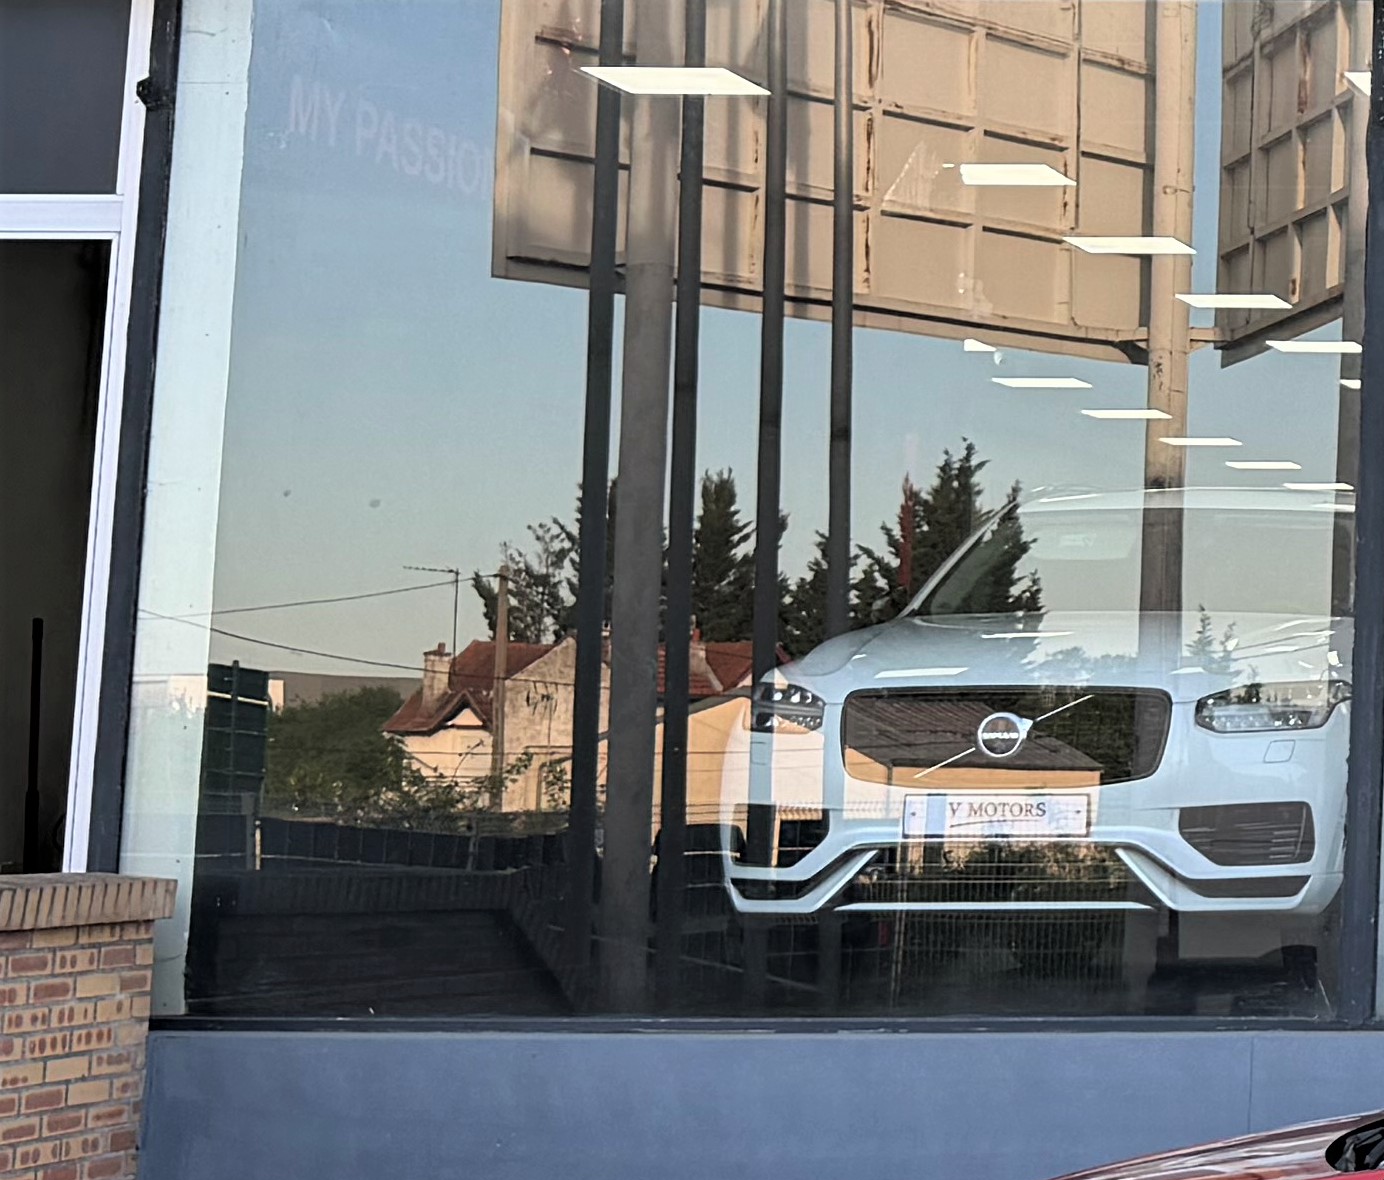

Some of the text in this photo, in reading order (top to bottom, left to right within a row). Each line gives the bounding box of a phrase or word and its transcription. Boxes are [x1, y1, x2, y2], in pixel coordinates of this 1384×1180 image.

[289, 74, 346, 147] MY
[949, 802, 1046, 817] V MOTORS
